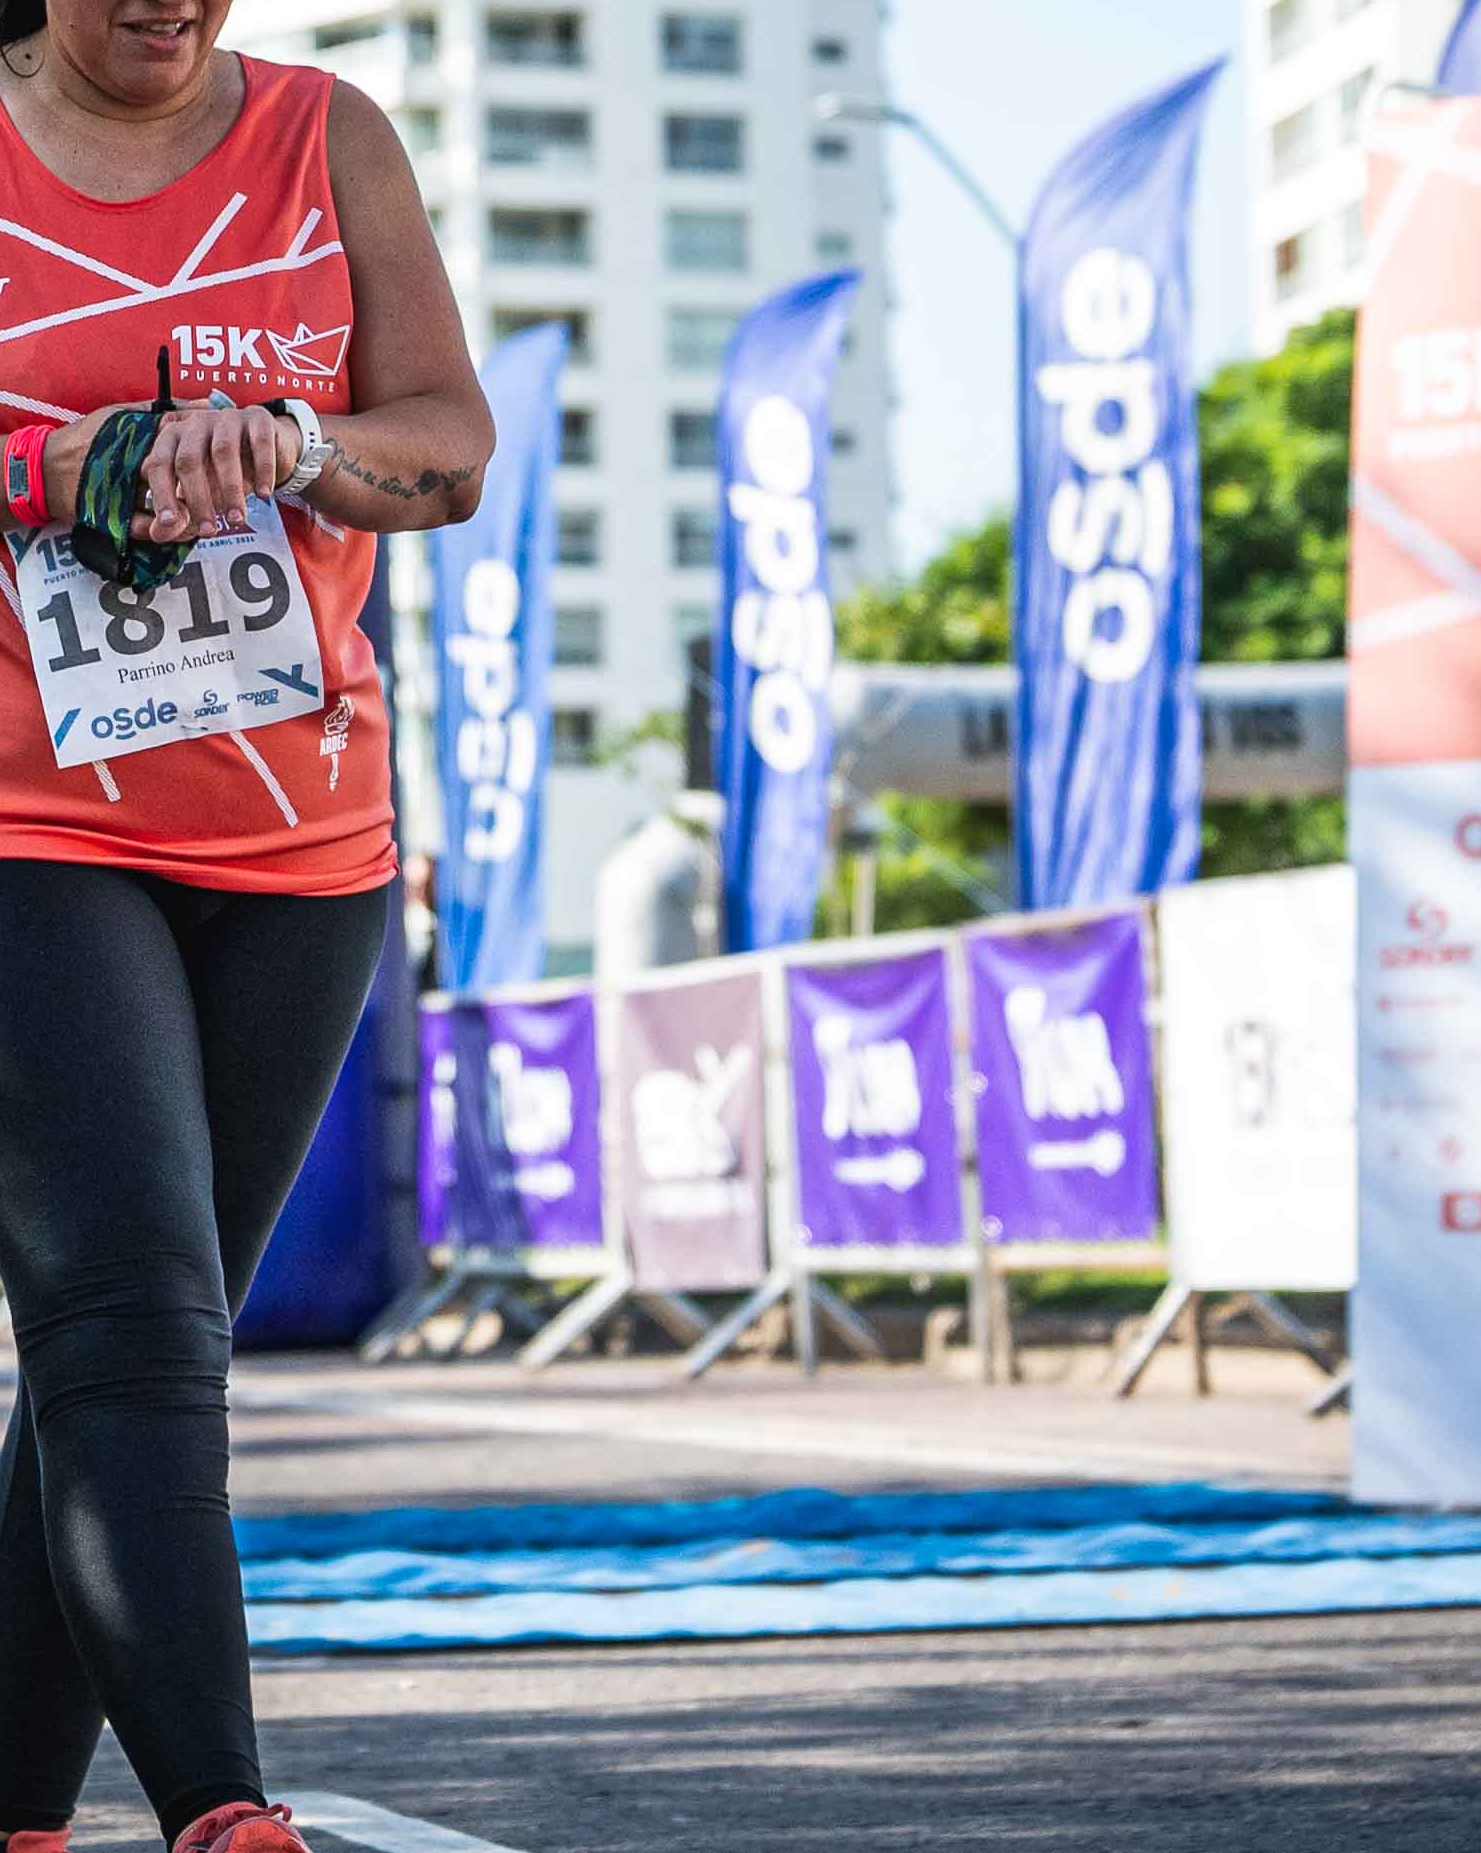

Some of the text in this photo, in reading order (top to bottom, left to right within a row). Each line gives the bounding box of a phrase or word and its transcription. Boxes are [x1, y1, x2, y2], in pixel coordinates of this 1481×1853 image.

[171, 324, 267, 368] 15K
[180, 369, 336, 393] PUERTO NORTE
[1037, 247, 1174, 683] osde
[43, 569, 77, 586] PUERTO
[729, 394, 835, 775] osde
[37, 551, 291, 674] 1819
[117, 648, 236, 685] Parrino Andrea
[91, 697, 178, 741] osde
